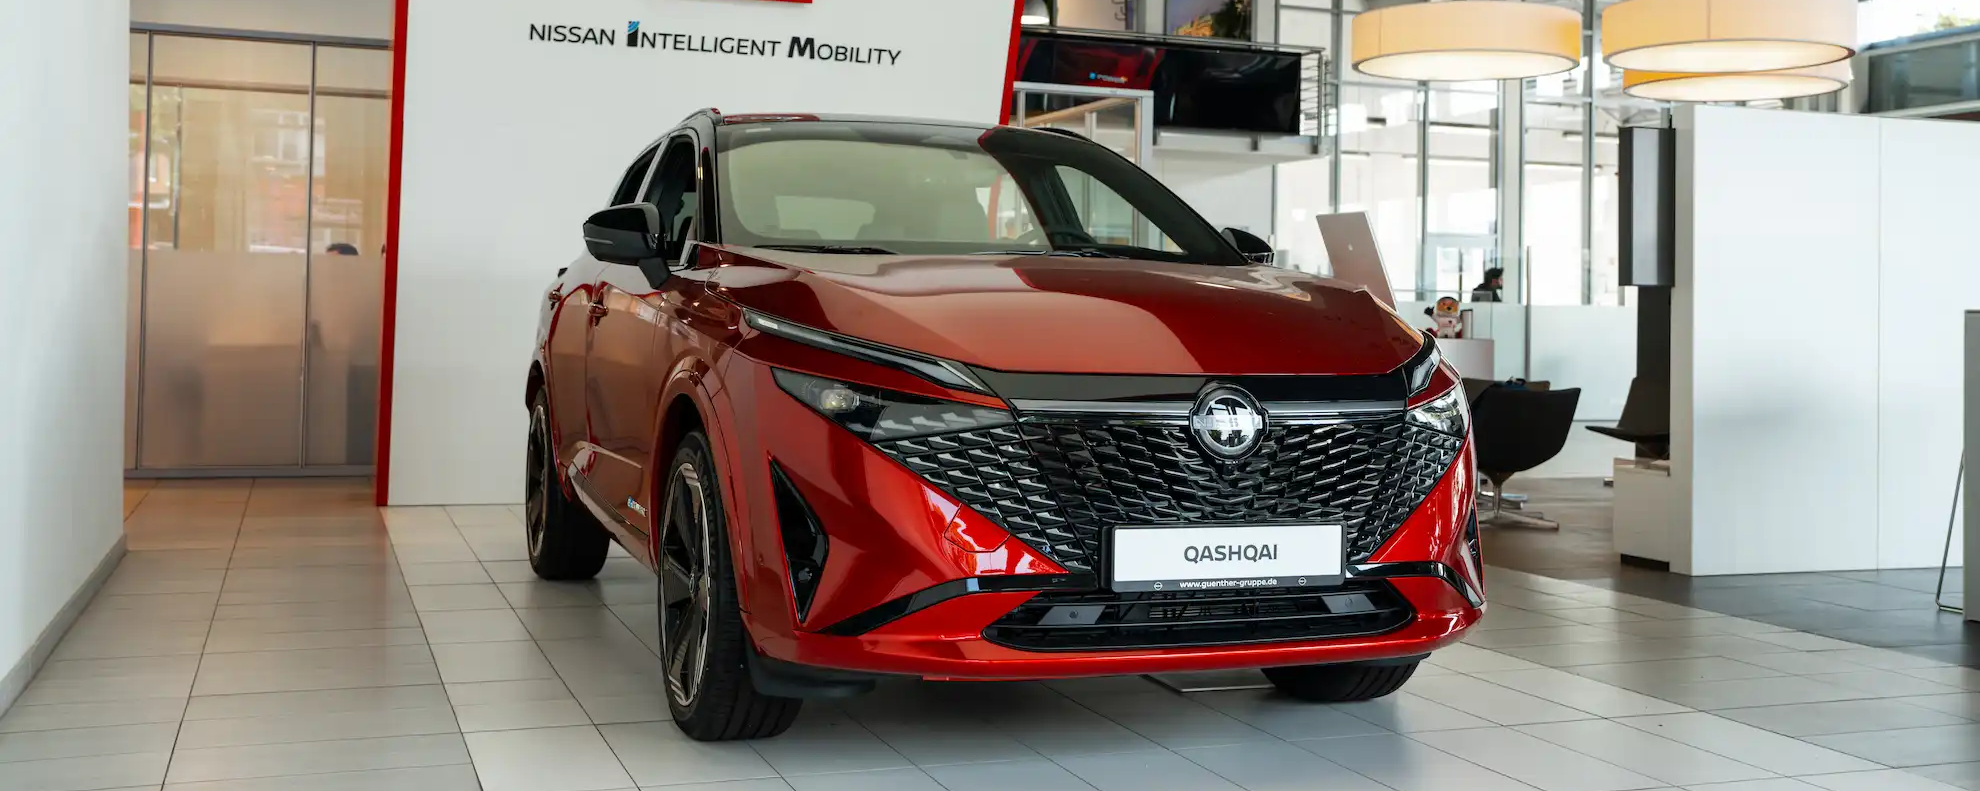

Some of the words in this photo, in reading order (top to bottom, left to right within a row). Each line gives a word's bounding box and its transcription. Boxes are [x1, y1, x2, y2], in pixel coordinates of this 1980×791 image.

[529, 23, 616, 46] NISSAN
[627, 21, 782, 57] INTELLIGENT
[788, 36, 902, 66] MOBILITY
[1183, 544, 1278, 564] QASHQAI
[1179, 578, 1278, 589] www.guenther-gruppe.de
